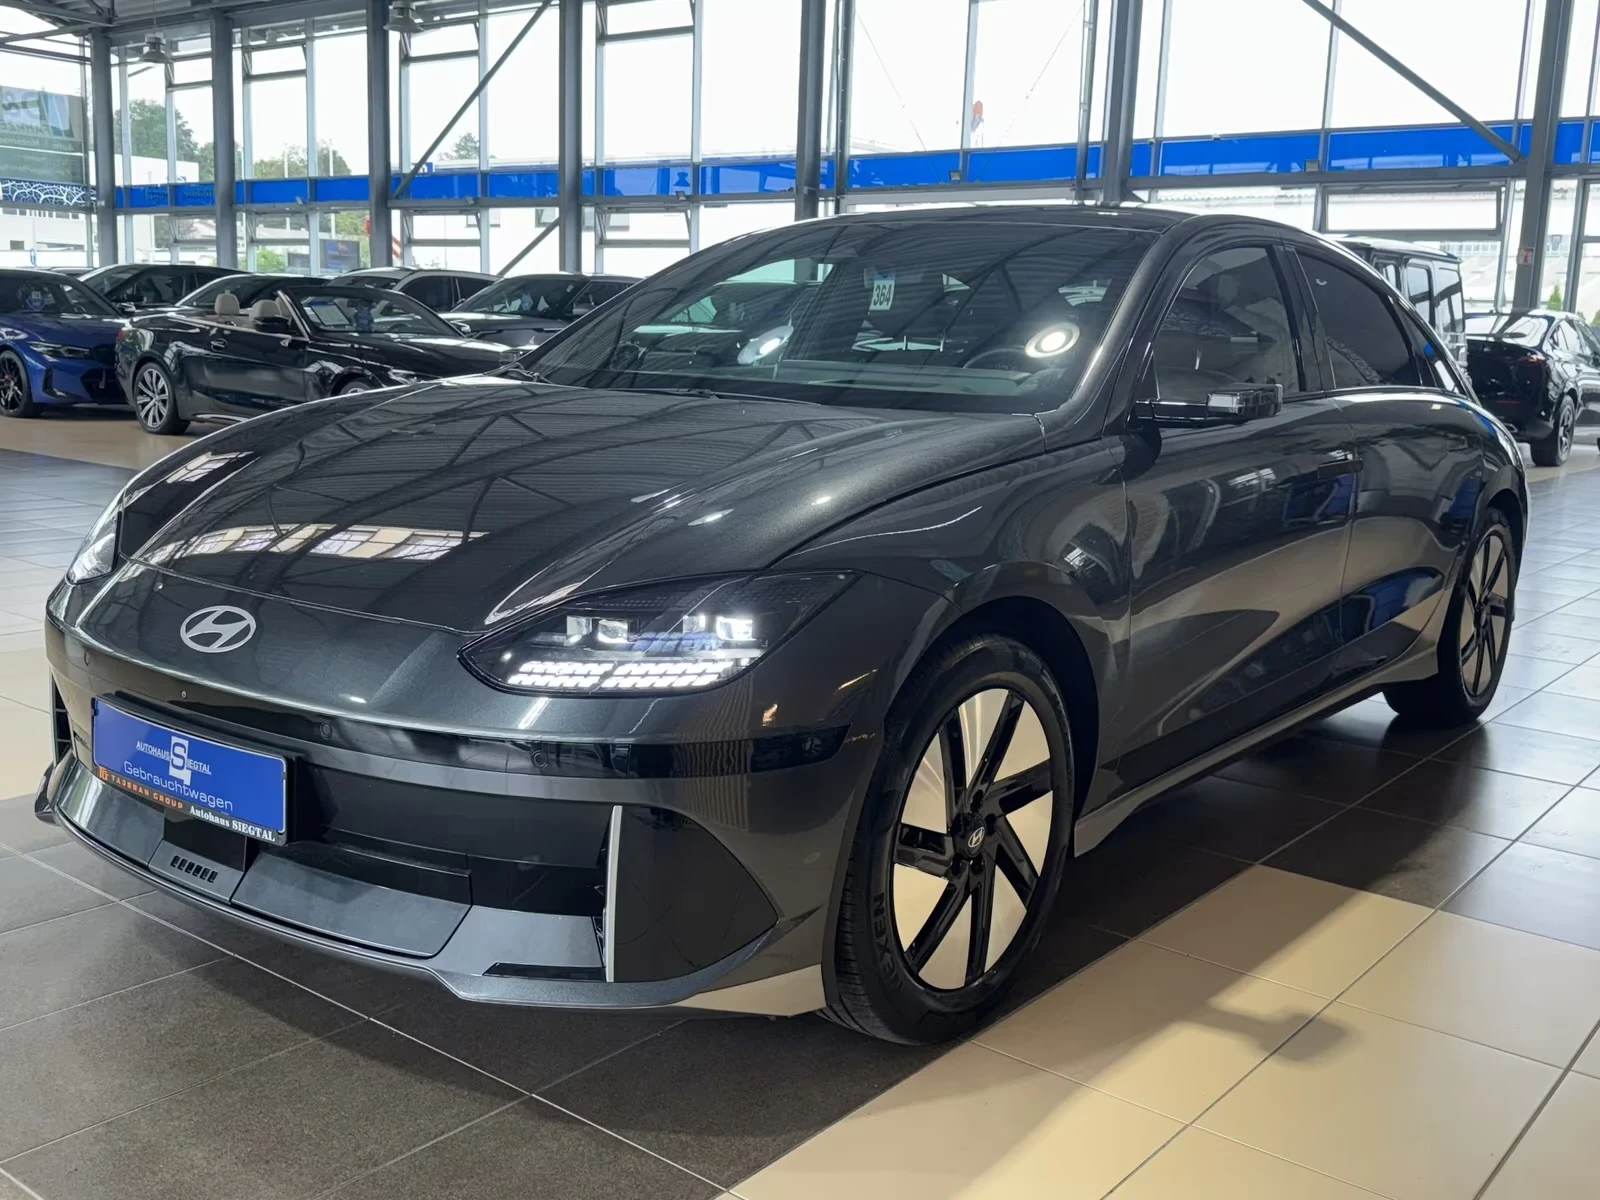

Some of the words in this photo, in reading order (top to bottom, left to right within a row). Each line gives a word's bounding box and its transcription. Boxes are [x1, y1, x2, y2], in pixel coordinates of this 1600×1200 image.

[873, 283, 892, 306] 364
[136, 740, 170, 761] AUTOHAUS
[123, 760, 234, 812] Gebrauchtwagen
[152, 792, 184, 809] GROUP
[189, 805, 230, 827] Autohaus
[231, 820, 276, 842] SIEGTAL
